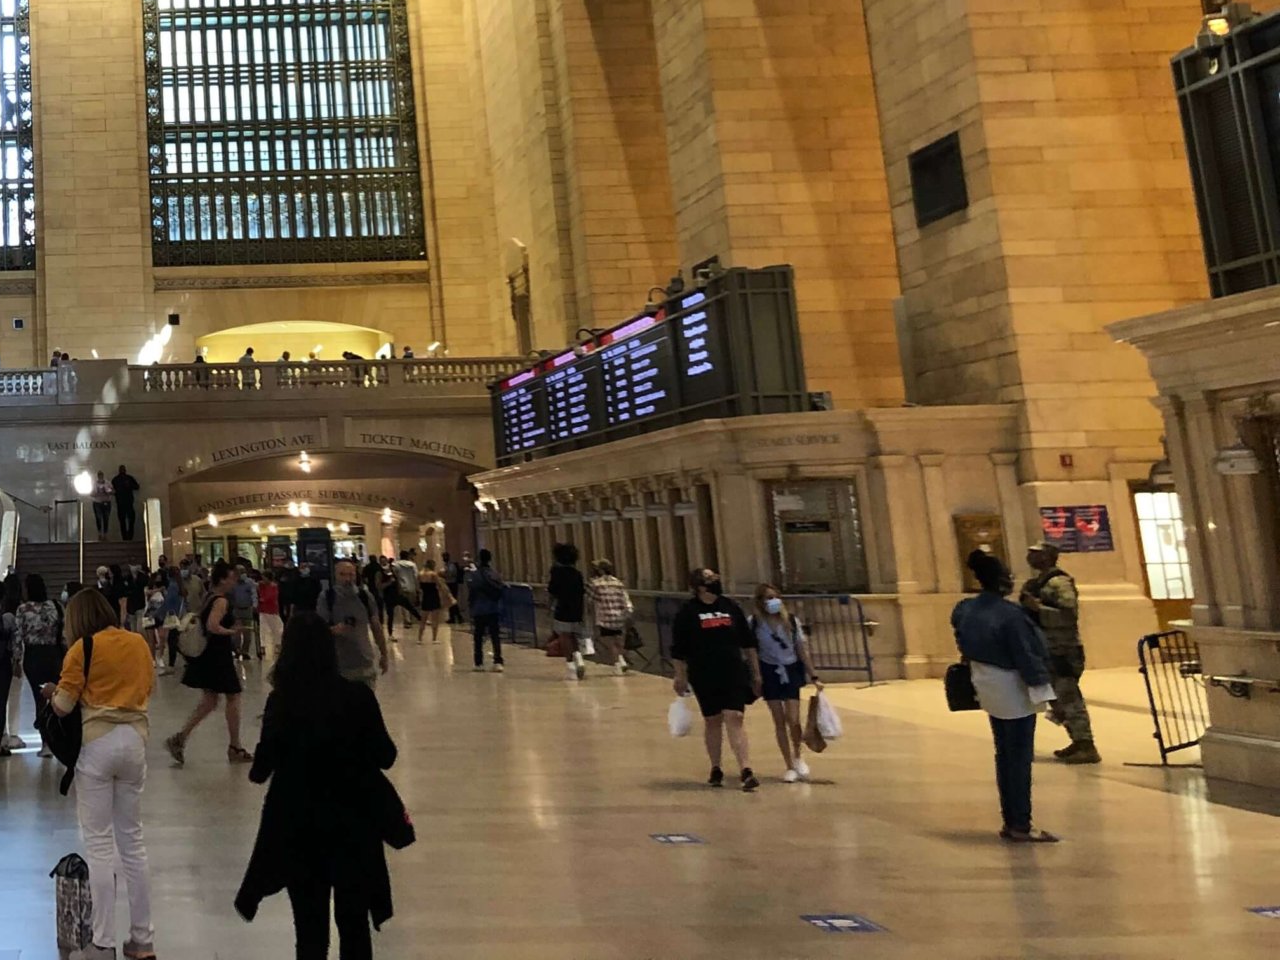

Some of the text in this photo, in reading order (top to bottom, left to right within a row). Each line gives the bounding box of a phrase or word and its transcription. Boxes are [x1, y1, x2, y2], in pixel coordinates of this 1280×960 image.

[47, 441, 70, 449] EAST
[211, 434, 315, 462] LEXINGTON AVE
[360, 433, 476, 460] TICKET MACHINES
[227, 493, 265, 506] STREET
[268, 489, 312, 501] PASSAGE
[319, 489, 363, 500] SUBWAY
